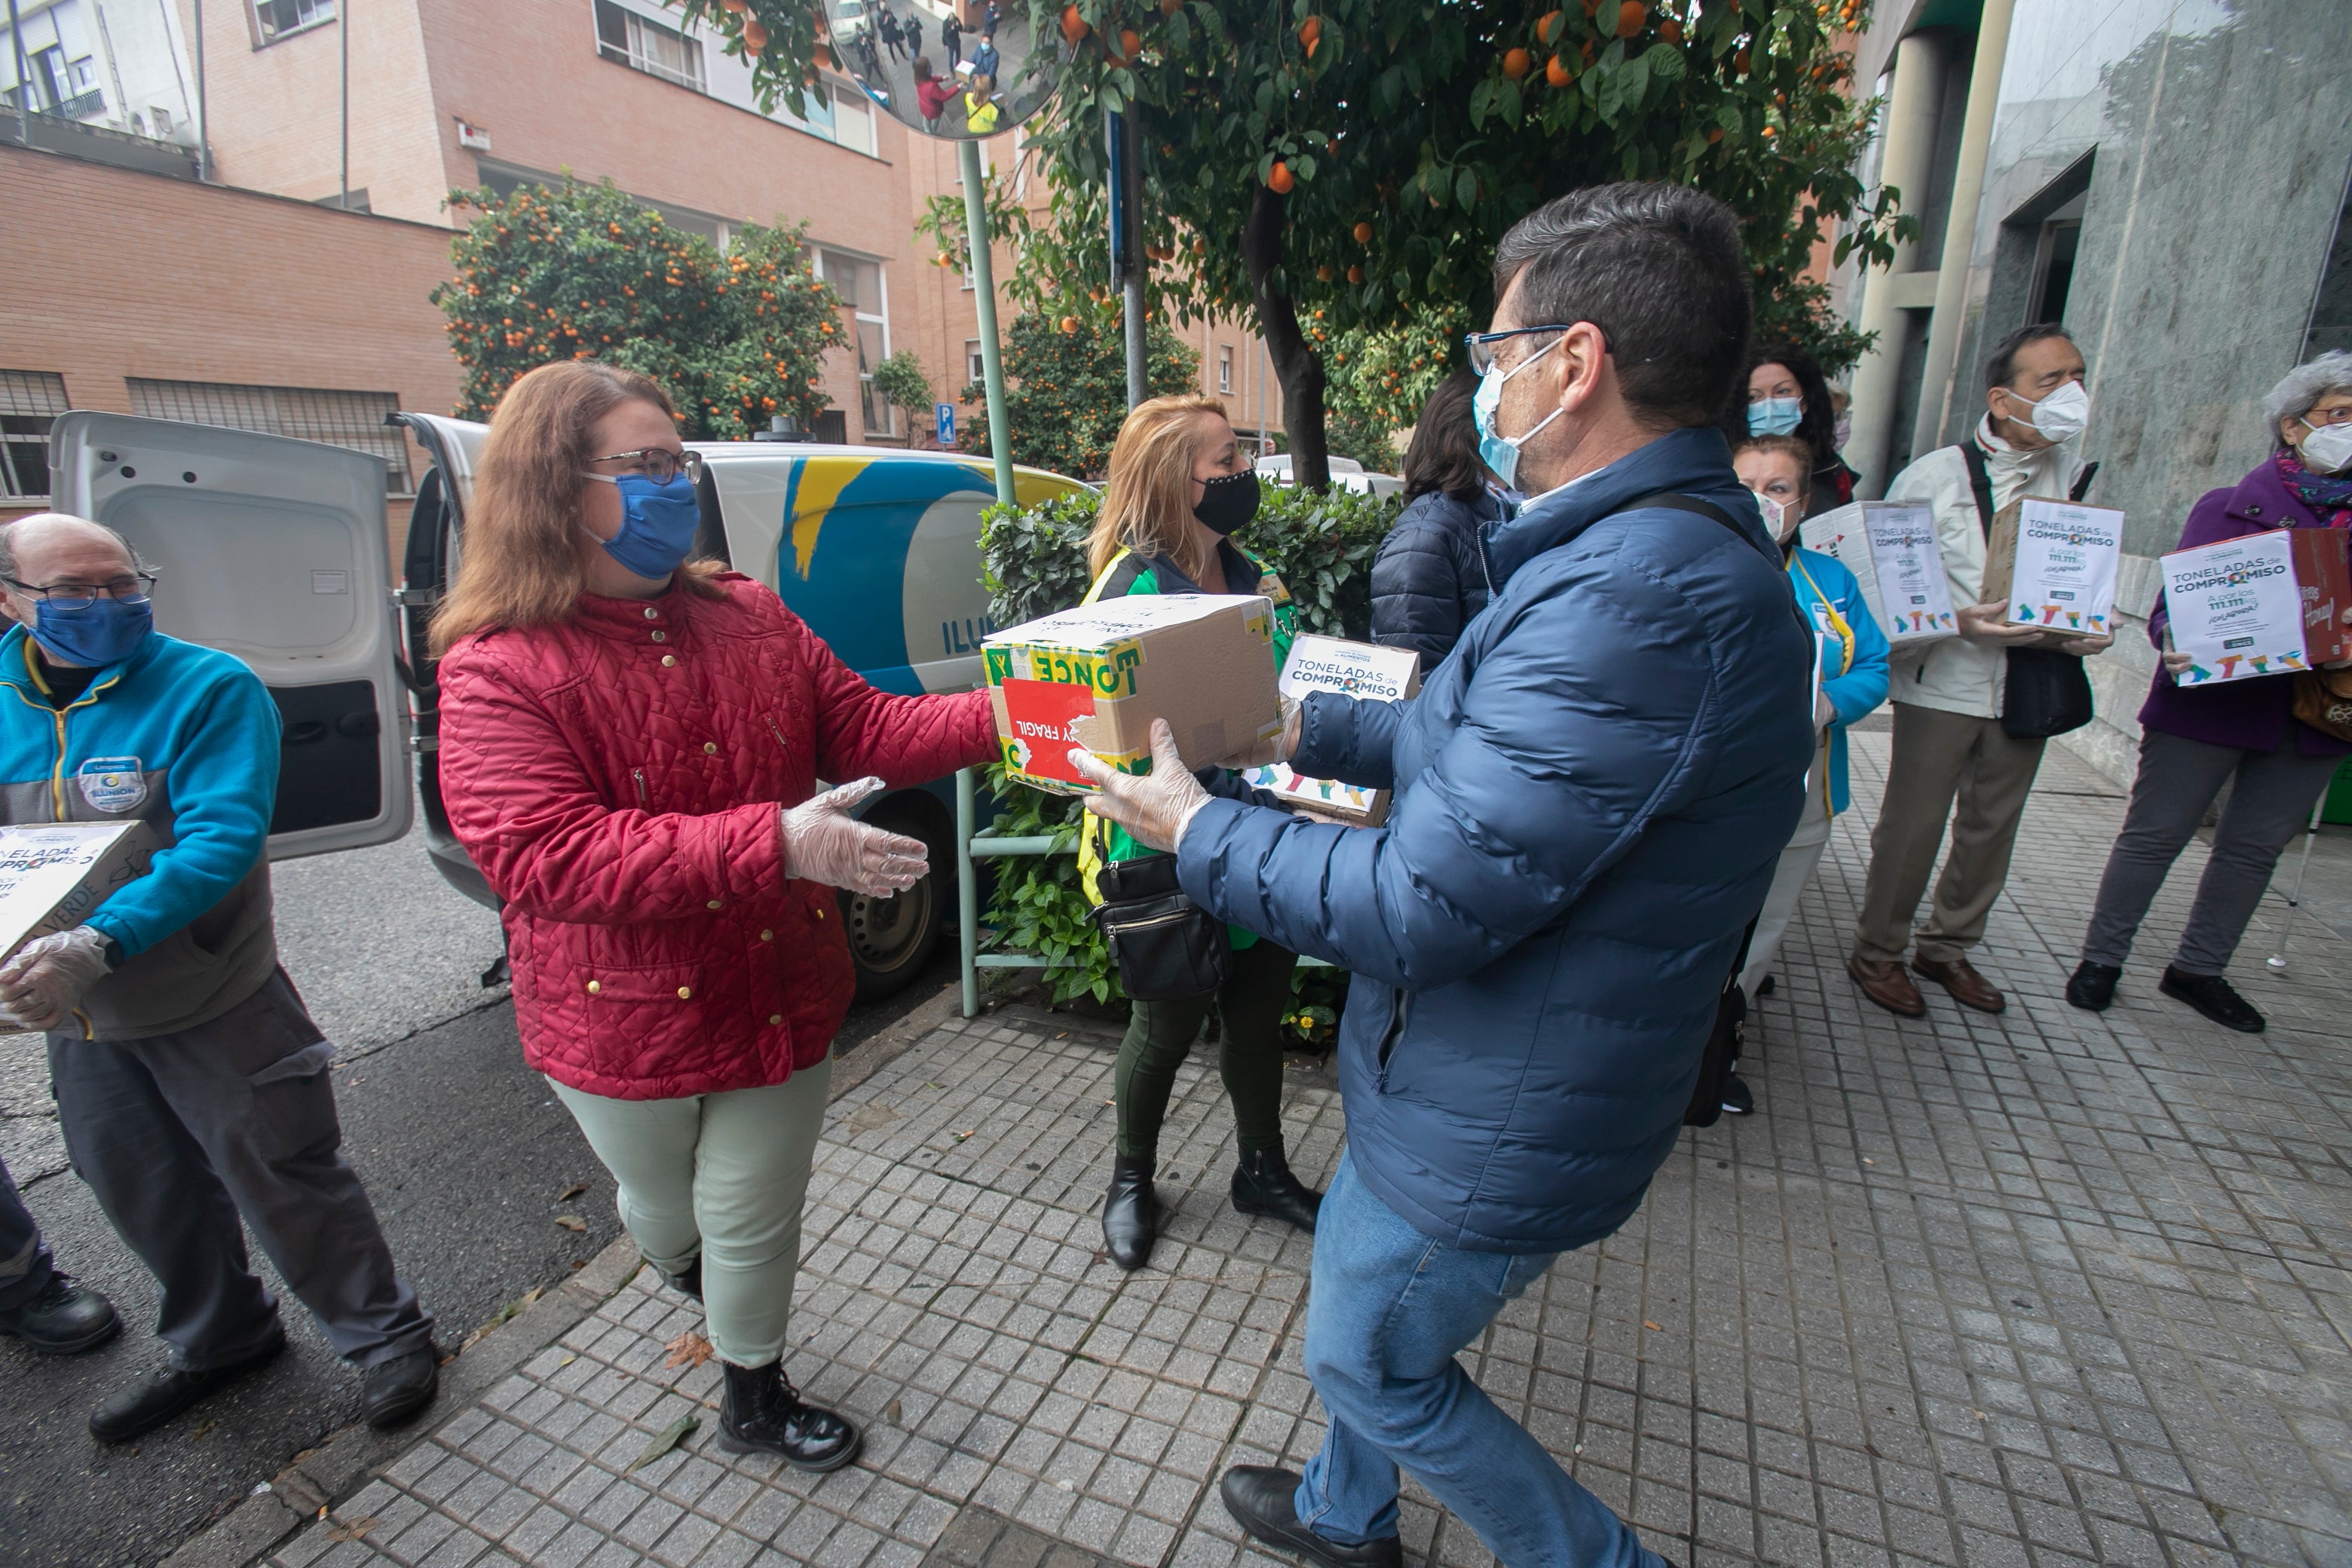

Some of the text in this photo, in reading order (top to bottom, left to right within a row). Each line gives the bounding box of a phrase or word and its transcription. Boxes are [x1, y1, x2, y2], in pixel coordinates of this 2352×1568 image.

[942, 407, 950, 422] P
[1873, 527, 1922, 536] TONELADAS
[2029, 519, 2100, 535] TONELADAS
[1876, 536, 1933, 547] COMPROMISO
[2027, 529, 2114, 547] COMPROMISO
[2173, 556, 2282, 583] TONELADAS de
[2174, 565, 2286, 593] COMPROMISO
[2219, 592, 2237, 602] por
[1340, 654, 1370, 663] ALIMENTOS
[1297, 659, 1398, 685] TONELADAS de
[1292, 670, 1398, 697] COMPROMISO
[1015, 720, 1059, 740] FRAGIL
[43, 880, 99, 933] VERDE
